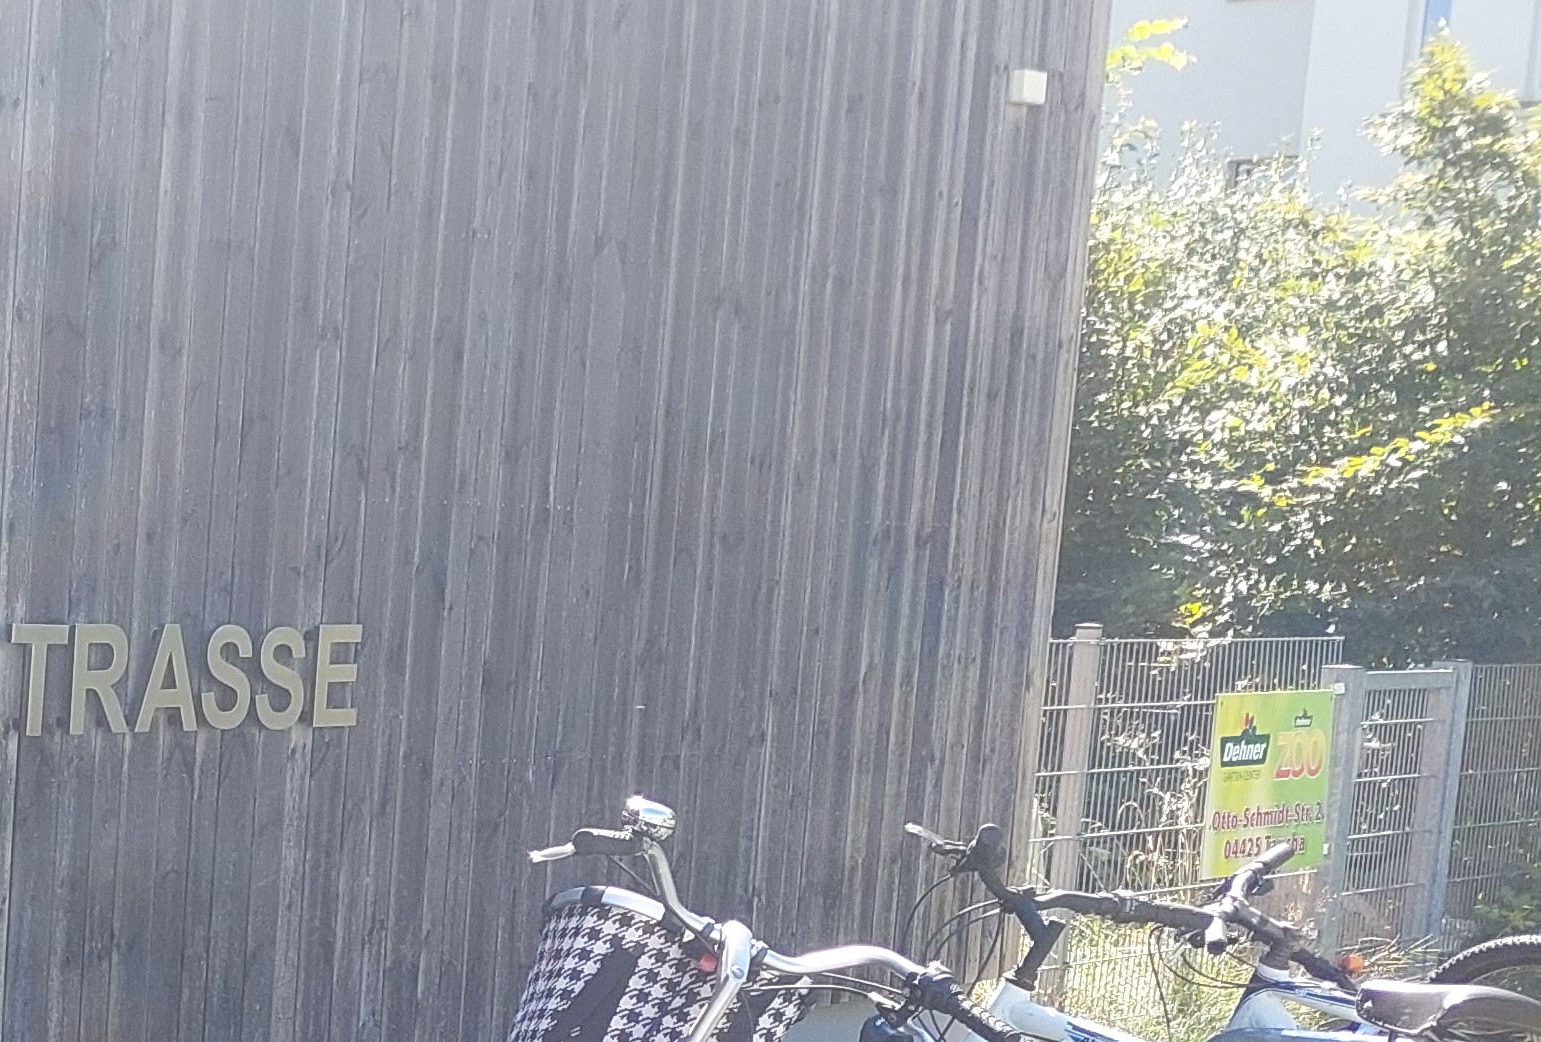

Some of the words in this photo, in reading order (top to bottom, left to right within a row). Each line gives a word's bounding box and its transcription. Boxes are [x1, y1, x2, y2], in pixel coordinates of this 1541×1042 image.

[1222, 740, 1267, 762] Dehner
[1274, 730, 1326, 780] ZOO
[1224, 837, 1261, 860] 04425
